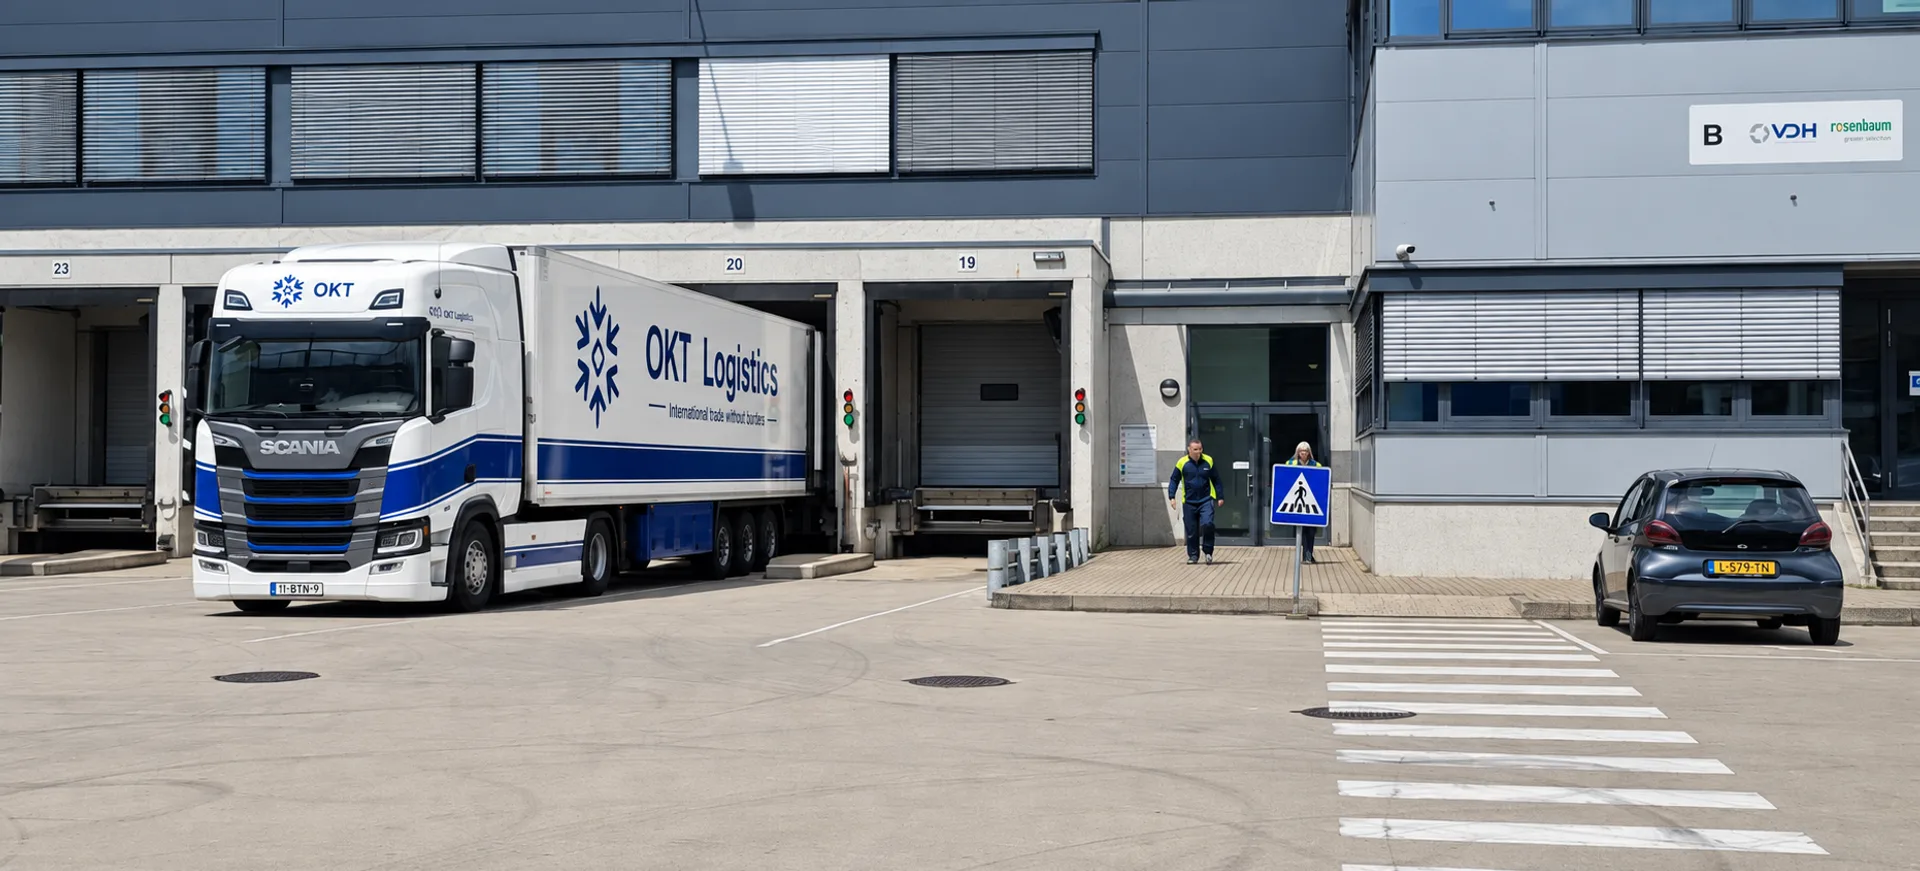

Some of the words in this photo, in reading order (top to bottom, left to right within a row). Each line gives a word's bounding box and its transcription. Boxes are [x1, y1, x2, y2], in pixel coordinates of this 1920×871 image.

[1771, 123, 1817, 139] VDH
[1831, 118, 1892, 132] rosenbaum
[1703, 124, 1723, 146] B
[53, 262, 69, 275] 23
[726, 257, 743, 271] 20
[959, 256, 976, 269] 19
[313, 282, 355, 297] OKT
[646, 325, 691, 383] OKT
[704, 337, 778, 403] Logistics
[669, 402, 708, 421] International
[709, 407, 724, 422] trade
[725, 408, 746, 425] without
[746, 410, 766, 426] borders
[260, 440, 340, 455] SCANIA
